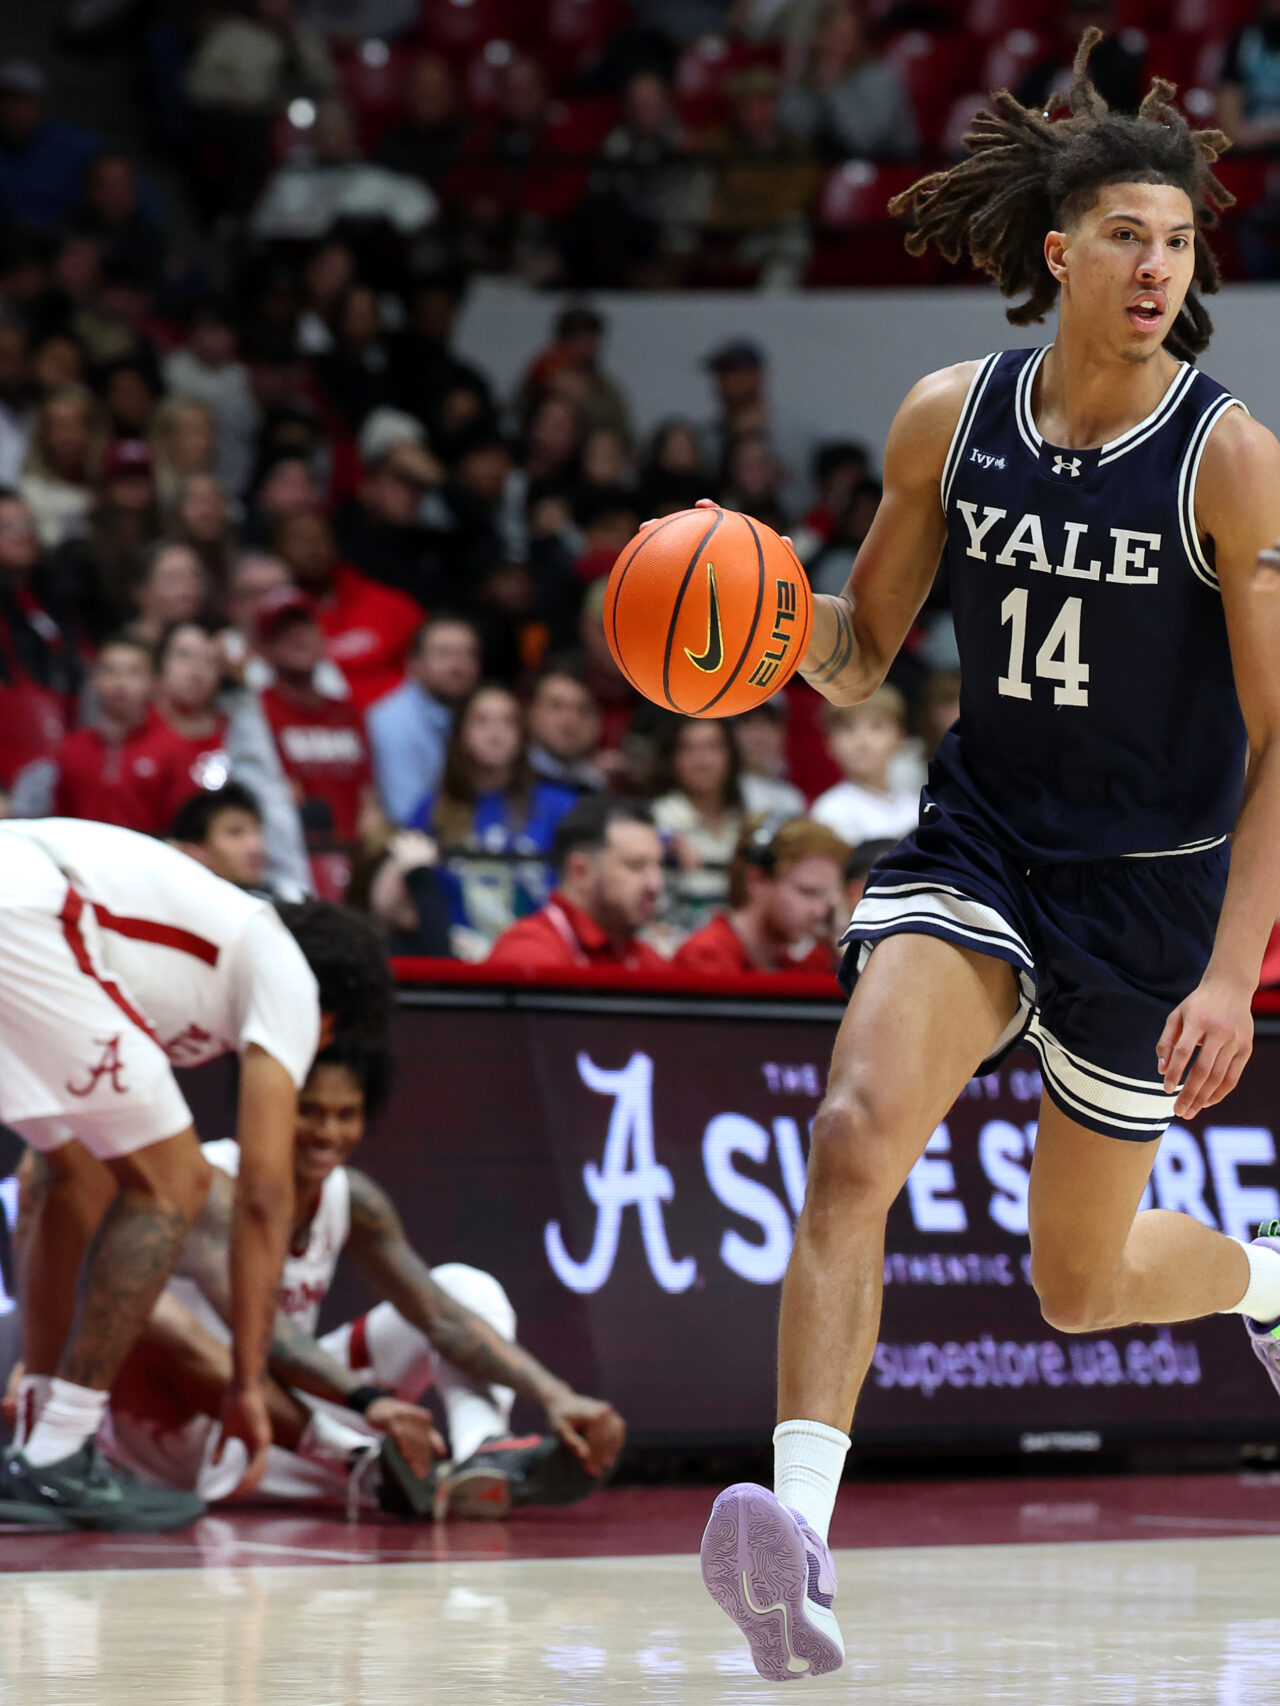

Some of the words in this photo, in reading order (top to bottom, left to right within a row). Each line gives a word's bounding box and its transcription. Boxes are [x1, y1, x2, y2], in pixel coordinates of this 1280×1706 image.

[969, 448, 996, 469] Ivy
[956, 499, 1162, 585] YALE
[748, 578, 796, 688] ELITE
[998, 587, 1090, 706] 14
[762, 1062, 822, 1097] THE
[702, 1112, 970, 1285] SE
[883, 1253, 1015, 1286] THENTIC
[872, 1331, 1200, 1398] supestore.ua.edu
